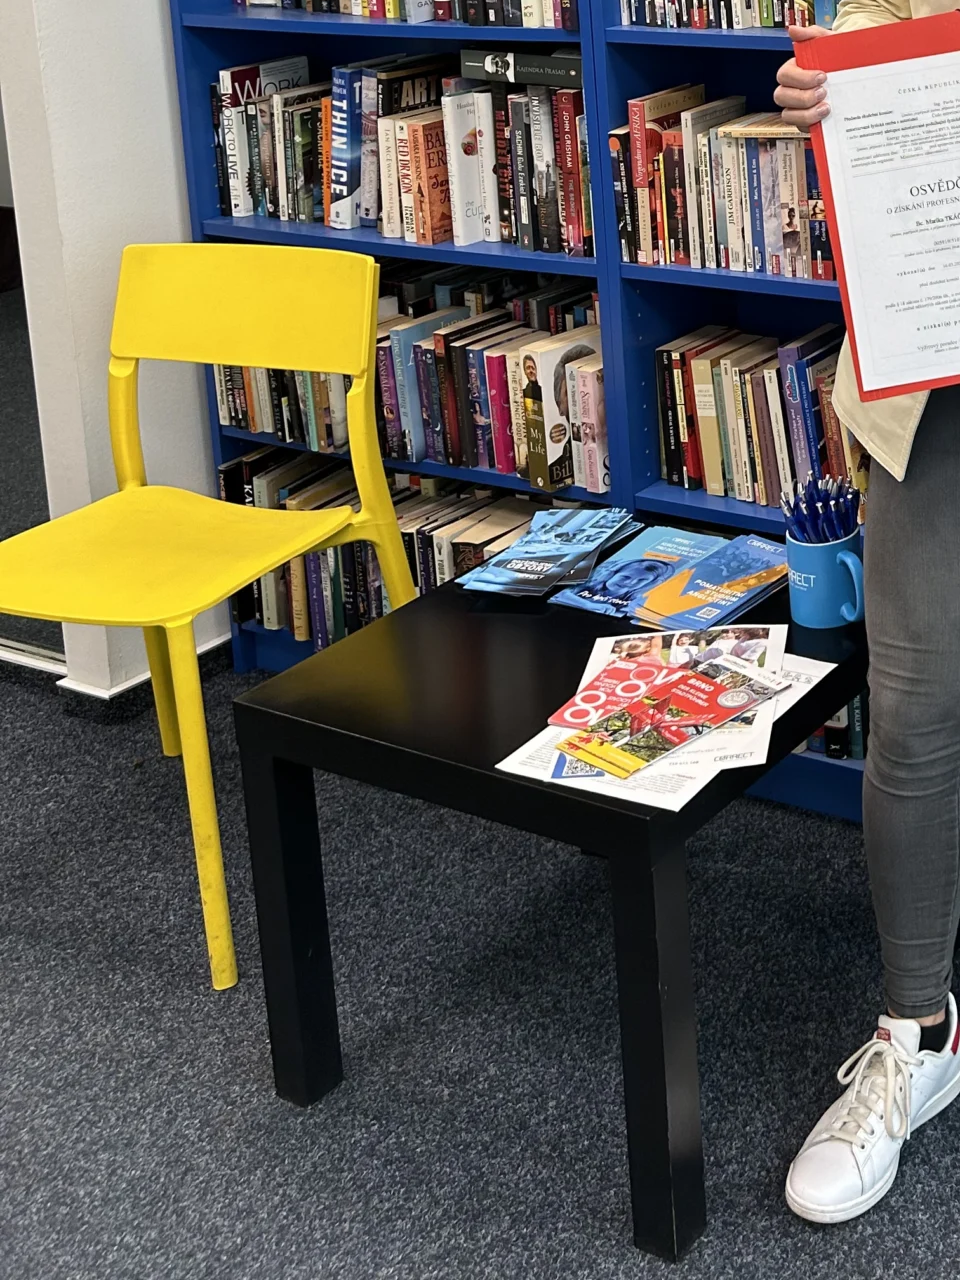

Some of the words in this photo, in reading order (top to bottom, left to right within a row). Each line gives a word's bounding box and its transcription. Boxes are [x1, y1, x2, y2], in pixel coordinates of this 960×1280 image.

[235, 76, 302, 104] WORK
[402, 77, 438, 105] ART
[221, 95, 233, 135] WORK
[331, 99, 347, 146] THIN
[563, 111, 571, 131] JOHN
[631, 107, 641, 136] AFRIKA
[227, 137, 236, 151] TO
[398, 138, 406, 158] RED
[228, 152, 238, 180] LIVE
[331, 161, 347, 196] ICE
[400, 161, 411, 194] DRAGON
[635, 146, 645, 184] Nirgendwo
[725, 168, 733, 210] GARRISON
[894, 202, 925, 213] ZÍSKÁNÍ
[926, 217, 944, 225] Marika
[530, 428, 543, 442] My
[530, 442, 545, 456] Life
[687, 677, 714, 692] BRNO
